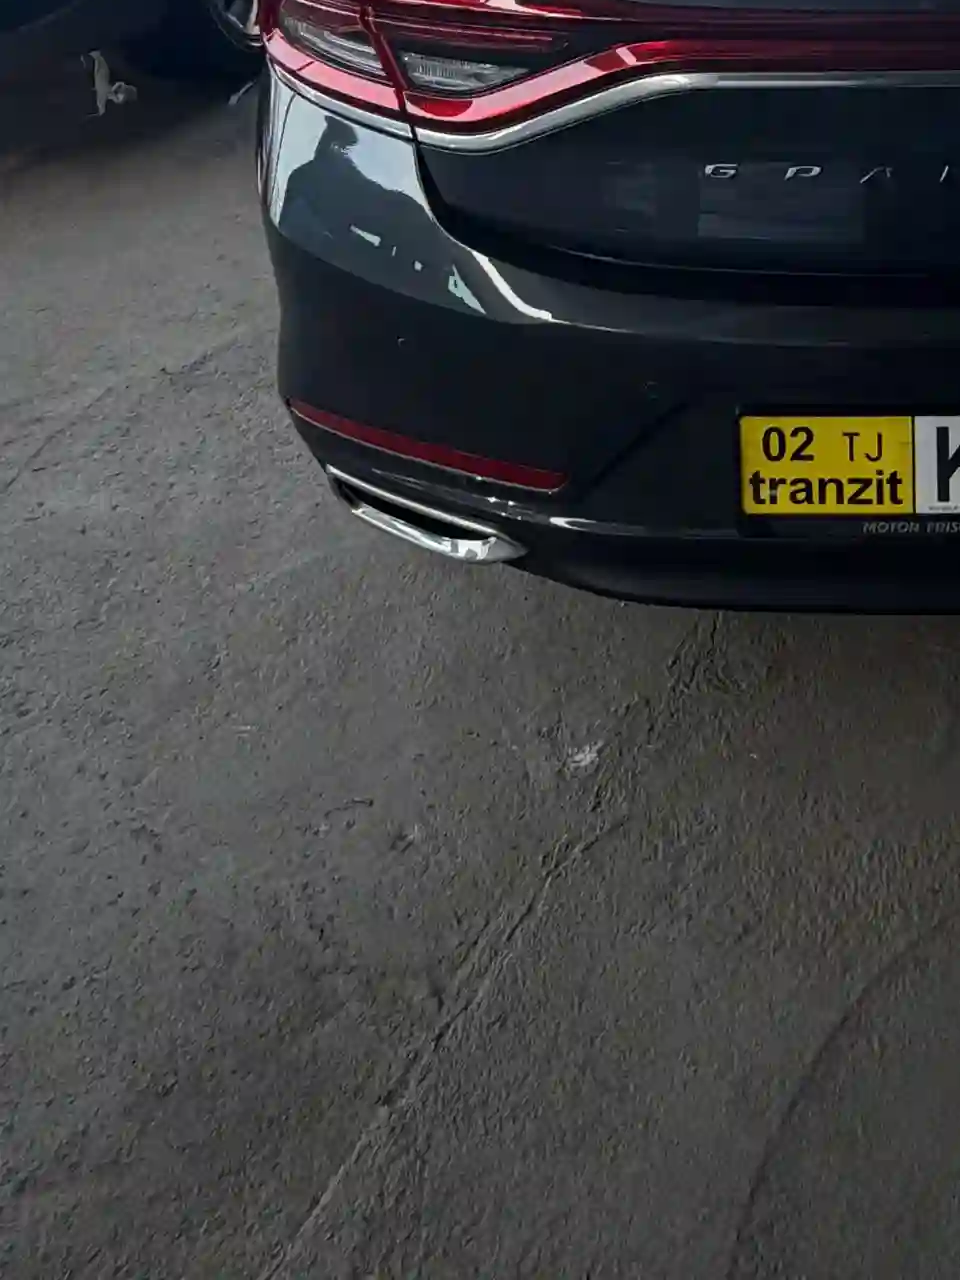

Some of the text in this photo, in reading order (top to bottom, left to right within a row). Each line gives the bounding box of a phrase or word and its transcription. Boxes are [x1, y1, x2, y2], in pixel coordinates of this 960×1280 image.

[762, 425, 884, 462] 02 TJ
[749, 468, 903, 506] tranzit
